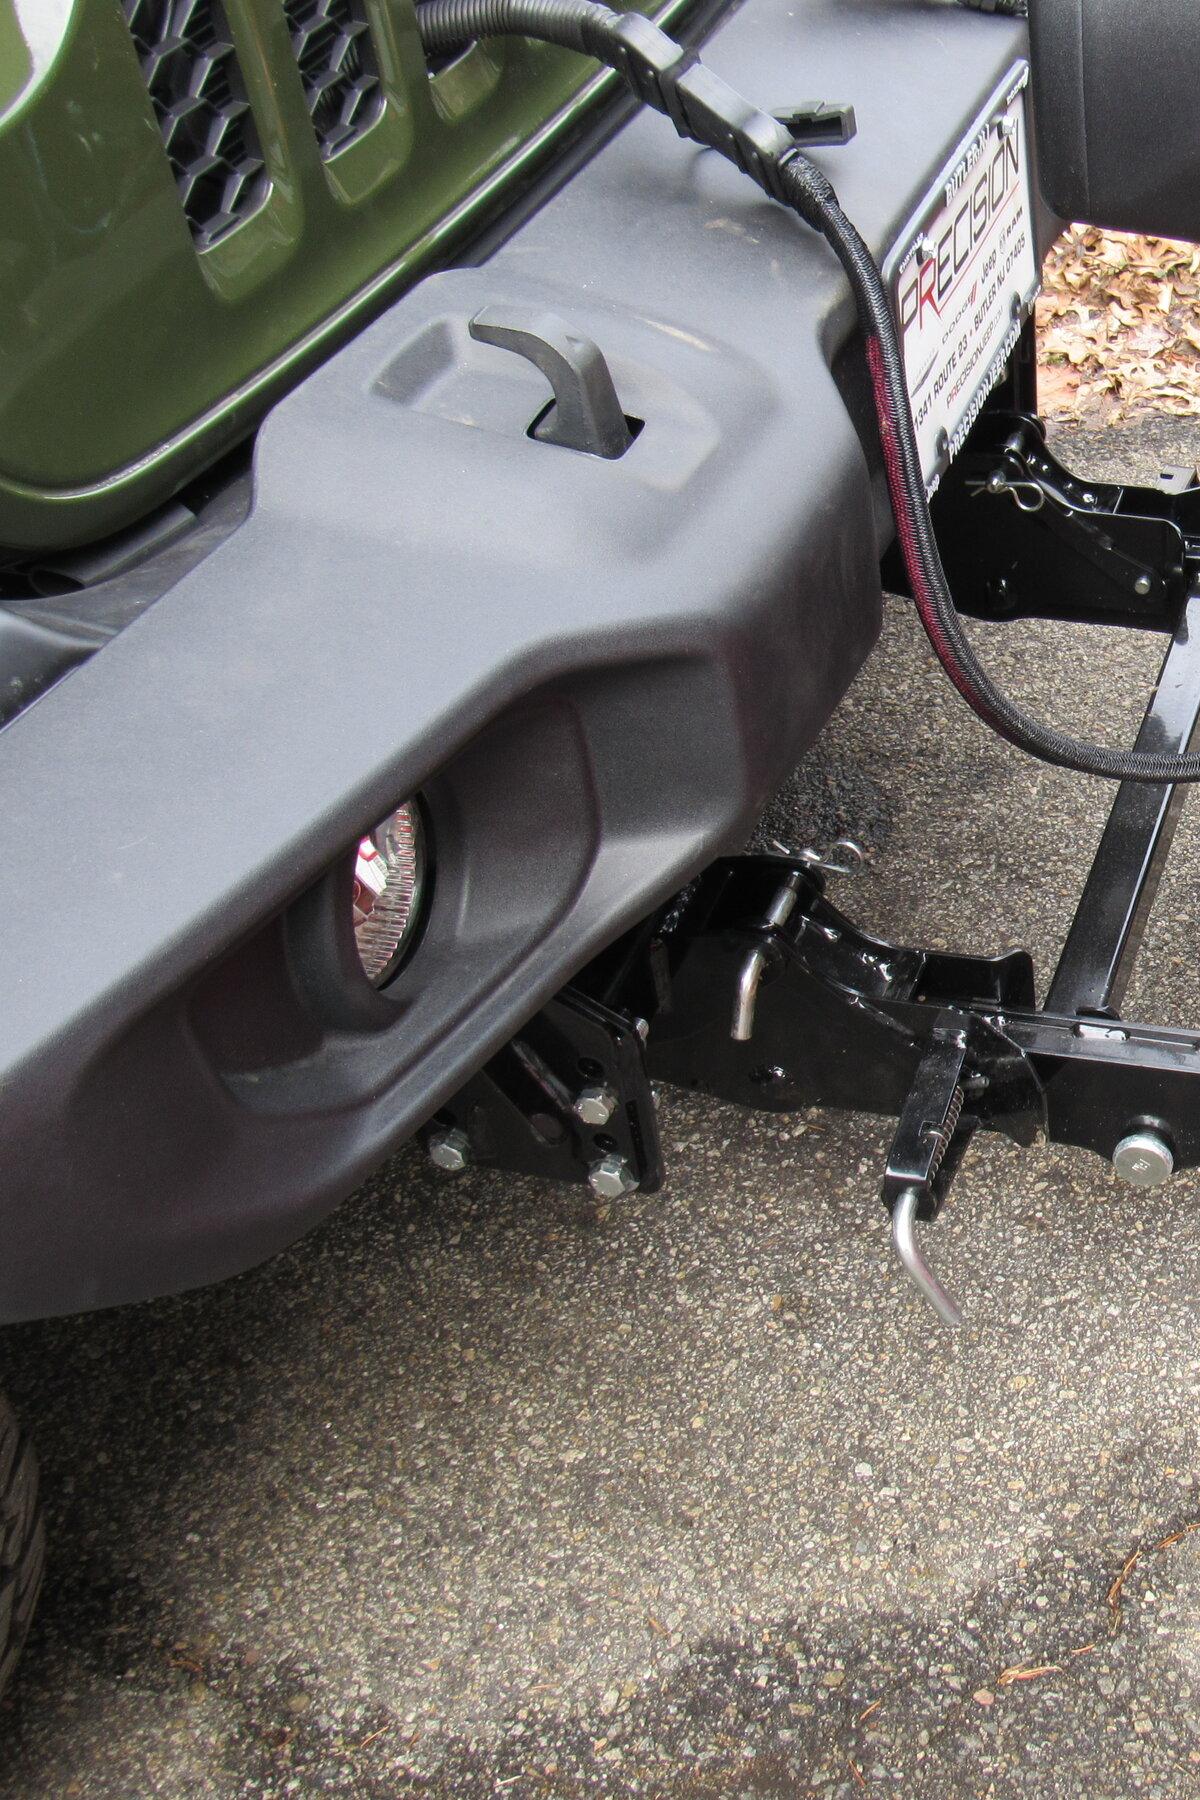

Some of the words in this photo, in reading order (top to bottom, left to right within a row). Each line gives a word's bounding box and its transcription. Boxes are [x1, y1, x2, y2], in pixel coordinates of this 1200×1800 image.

[900, 118, 1020, 331] PRECISION
[981, 248, 997, 285] Jeep
[1006, 206, 1023, 237] RAM
[914, 394, 932, 431] 1341
[934, 356, 957, 399] ROUTE
[958, 333, 968, 360] 23
[973, 282, 997, 331] BUTLER
[997, 267, 1006, 291] NJ
[1005, 232, 1026, 273] 07405
